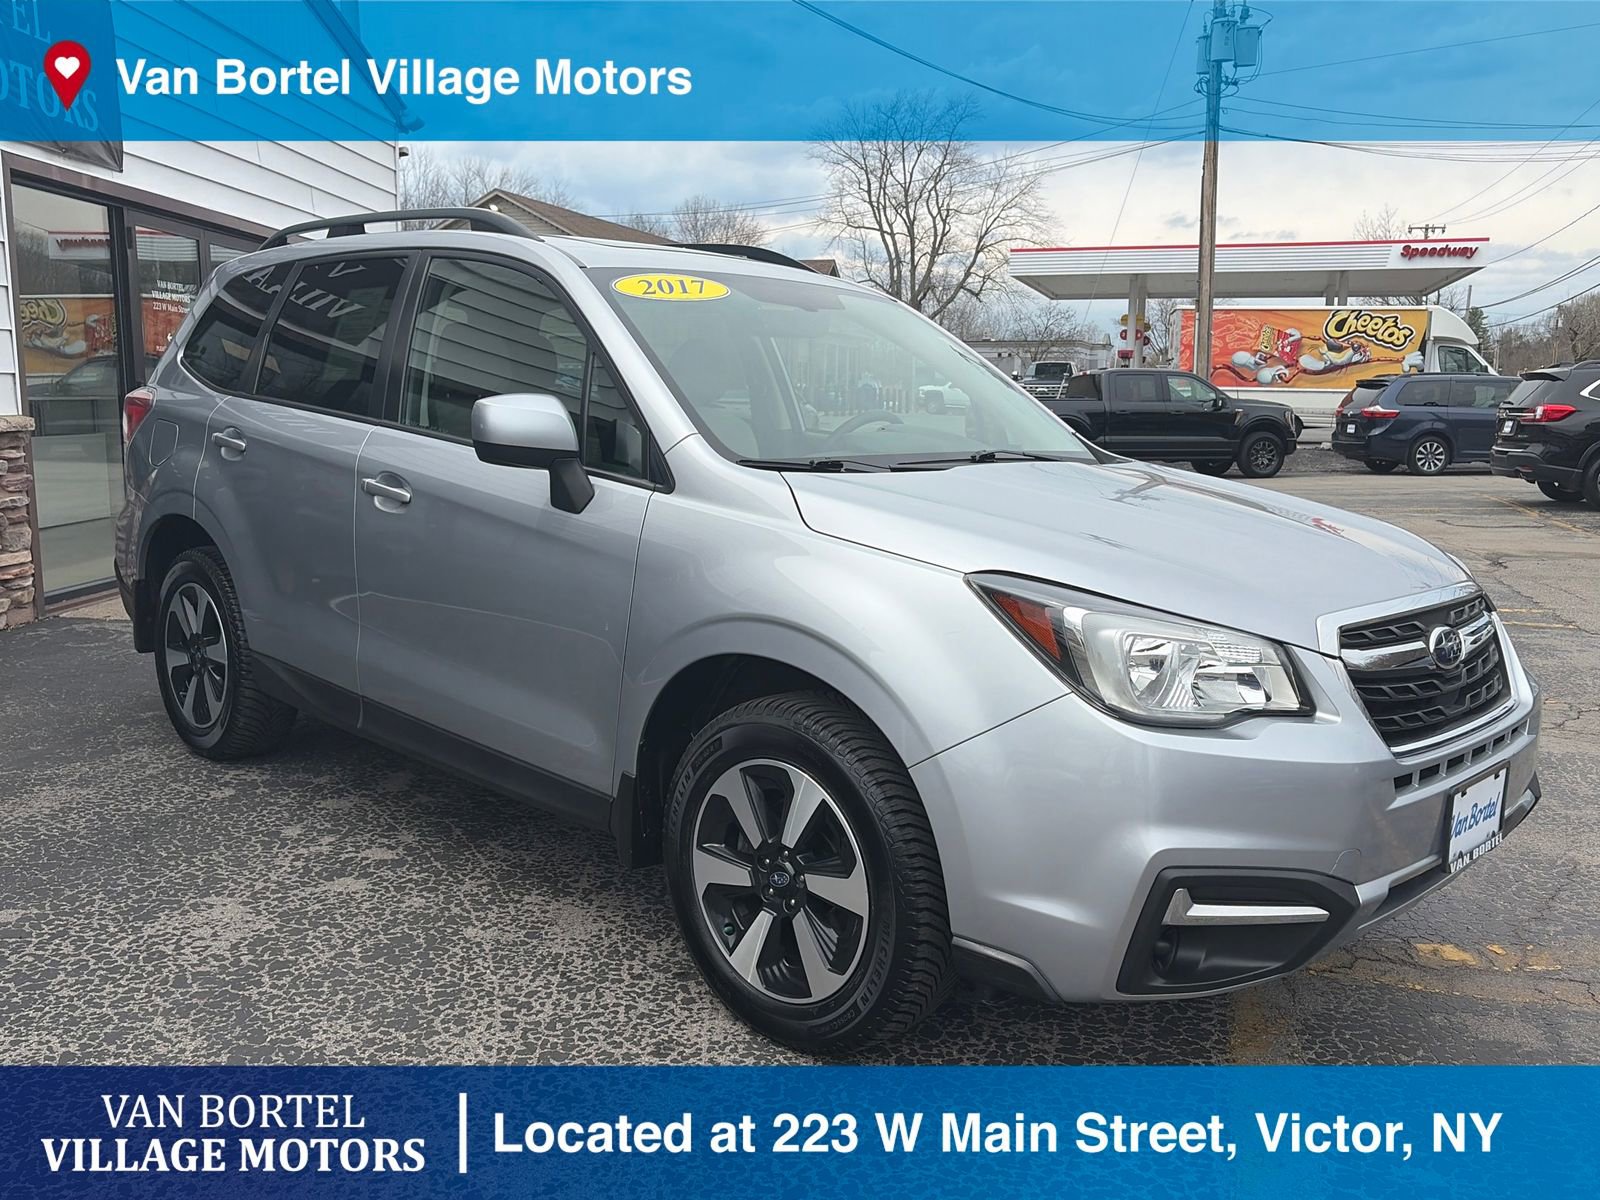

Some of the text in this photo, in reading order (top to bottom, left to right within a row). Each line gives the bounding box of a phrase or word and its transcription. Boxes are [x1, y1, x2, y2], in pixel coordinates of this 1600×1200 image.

[1400, 243, 1479, 260] Speedway
[156, 279, 167, 289] VAN
[637, 278, 705, 295] 2017
[151, 290, 191, 304] VILLAGE MOTORS
[152, 301, 161, 310] 223
[167, 303, 178, 312] Main
[1325, 308, 1413, 348] Cheetos
[1449, 792, 1501, 839] Van Bortel
[1450, 832, 1503, 873] VAN BORTEL
[859, 920, 891, 1007] MICHELIN
